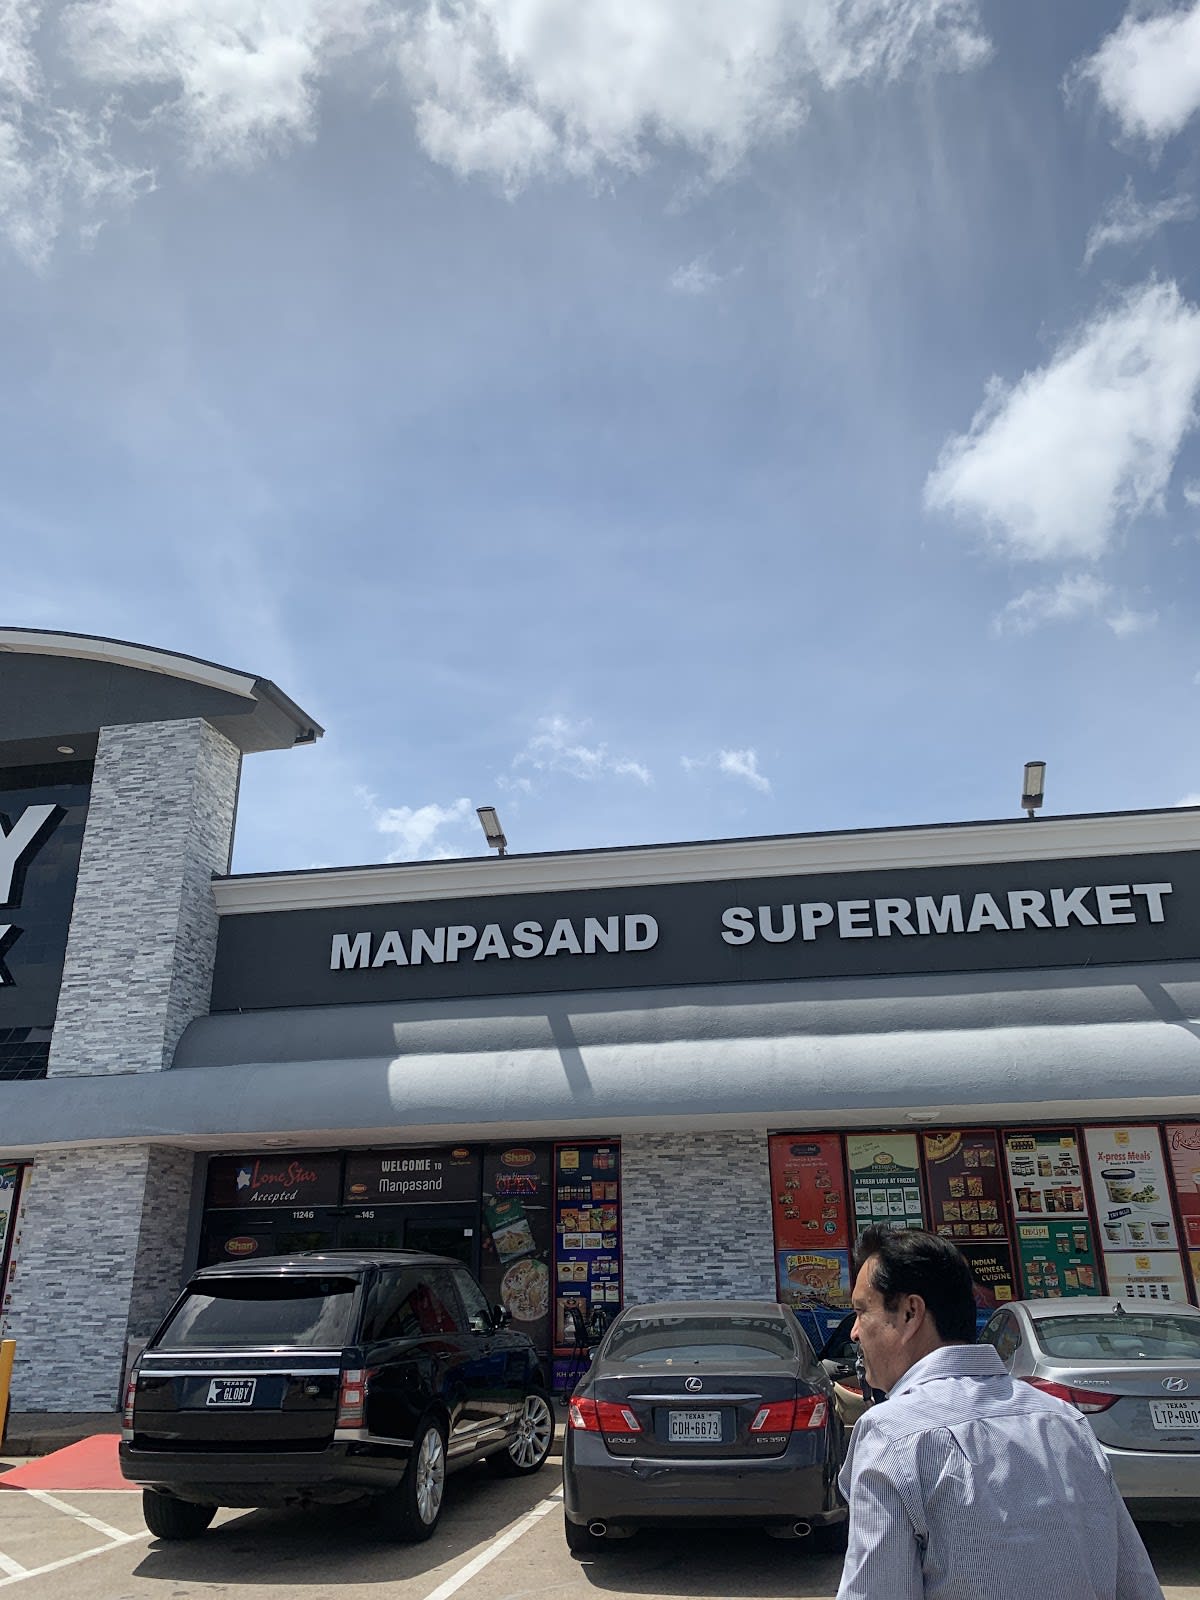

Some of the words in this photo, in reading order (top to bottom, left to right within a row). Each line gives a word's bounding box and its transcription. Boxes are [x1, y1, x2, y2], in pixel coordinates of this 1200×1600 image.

[330, 913, 660, 970] MANPASAND
[720, 882, 1173, 946] SUPERMARKET
[505, 1152, 531, 1163] Shan
[381, 1159, 431, 1172] WELCOME
[434, 1162, 442, 1170] TO
[379, 1177, 442, 1194] Manpasand
[250, 1189, 298, 1203] Accepted
[292, 1211, 314, 1219] 11246
[228, 1239, 253, 1251] Shan
[971, 1258, 997, 1266] INDIAN
[975, 1265, 1006, 1275] CHINESE
[981, 1273, 1012, 1281] CUISINE
[223, 1385, 249, 1400] GLOBY
